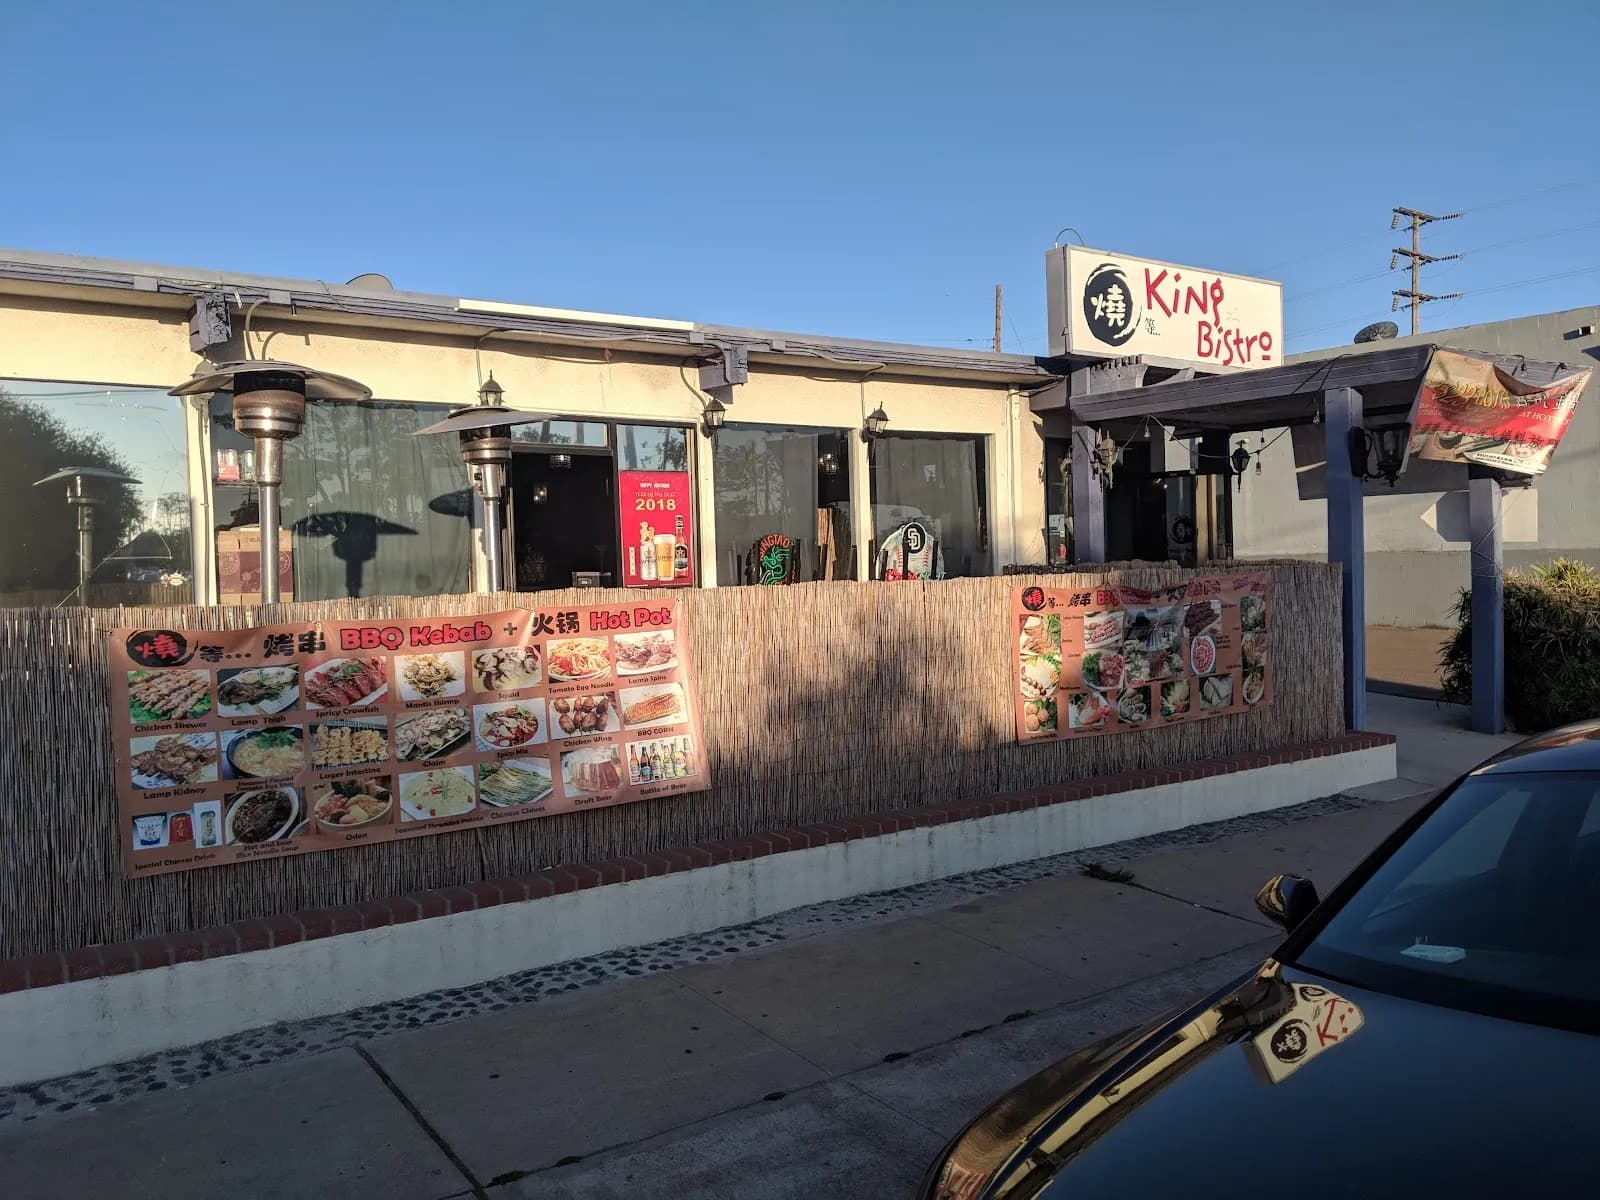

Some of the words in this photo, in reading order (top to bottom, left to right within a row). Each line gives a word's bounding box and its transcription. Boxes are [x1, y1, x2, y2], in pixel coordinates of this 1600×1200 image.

[1197, 320, 1273, 366] Bistro
[635, 498, 677, 511] 2018
[340, 626, 404, 650] BBQ
[409, 621, 492, 647] Kebab
[531, 611, 580, 637] 火锅
[589, 610, 631, 631] Hot
[634, 607, 672, 627] Pot
[549, 685, 575, 694] Tomato
[576, 684, 590, 692] Egg
[591, 681, 615, 690] Noodle
[637, 729, 652, 737] BBQ
[653, 726, 674, 735] CORN
[563, 737, 592, 747] Chicken
[593, 735, 613, 743] Wing
[143, 789, 172, 800] Lamp
[173, 785, 207, 798] Kidney
[345, 831, 368, 840] Oden
